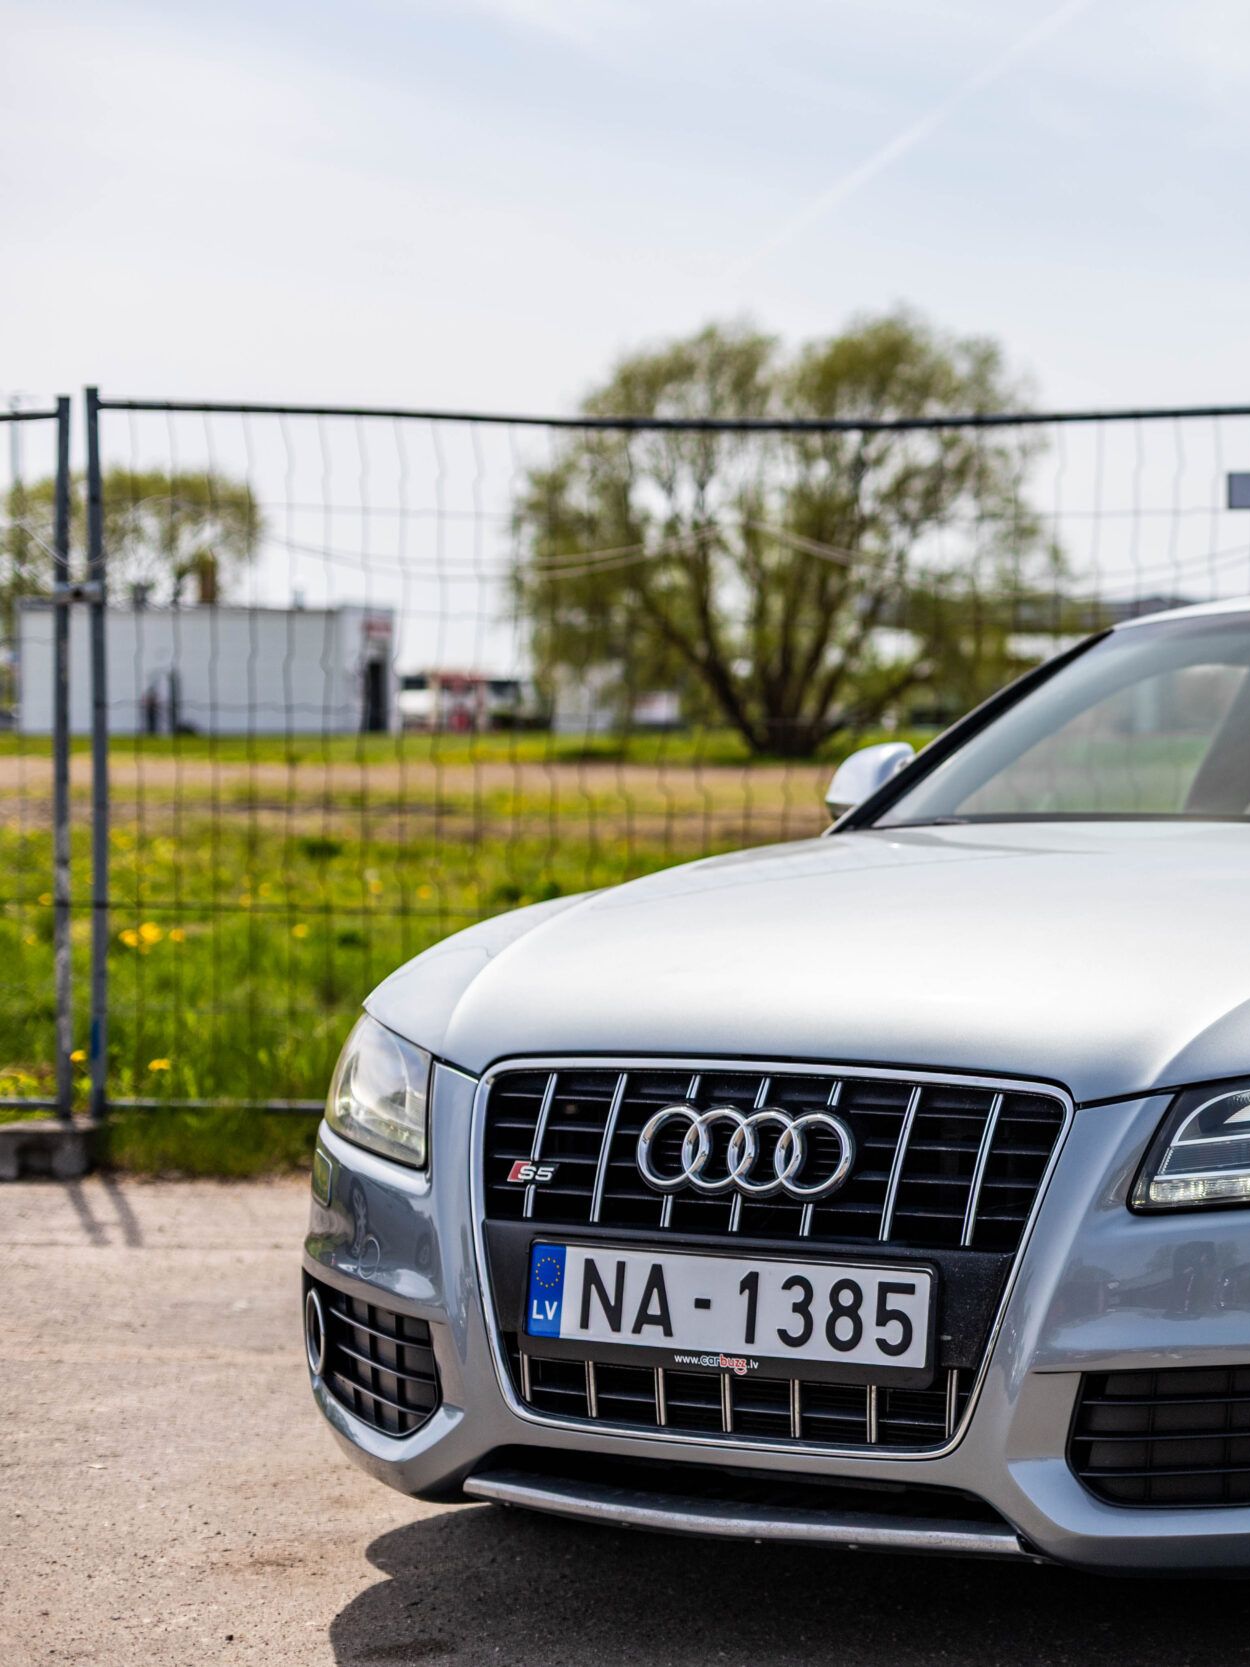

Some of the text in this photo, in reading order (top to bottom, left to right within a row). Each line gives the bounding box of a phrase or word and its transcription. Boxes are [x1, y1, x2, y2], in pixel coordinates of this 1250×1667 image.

[518, 1165, 554, 1181] S5
[532, 1299, 558, 1320] LV
[674, 1354, 759, 1370] www.carbuzz.lv
